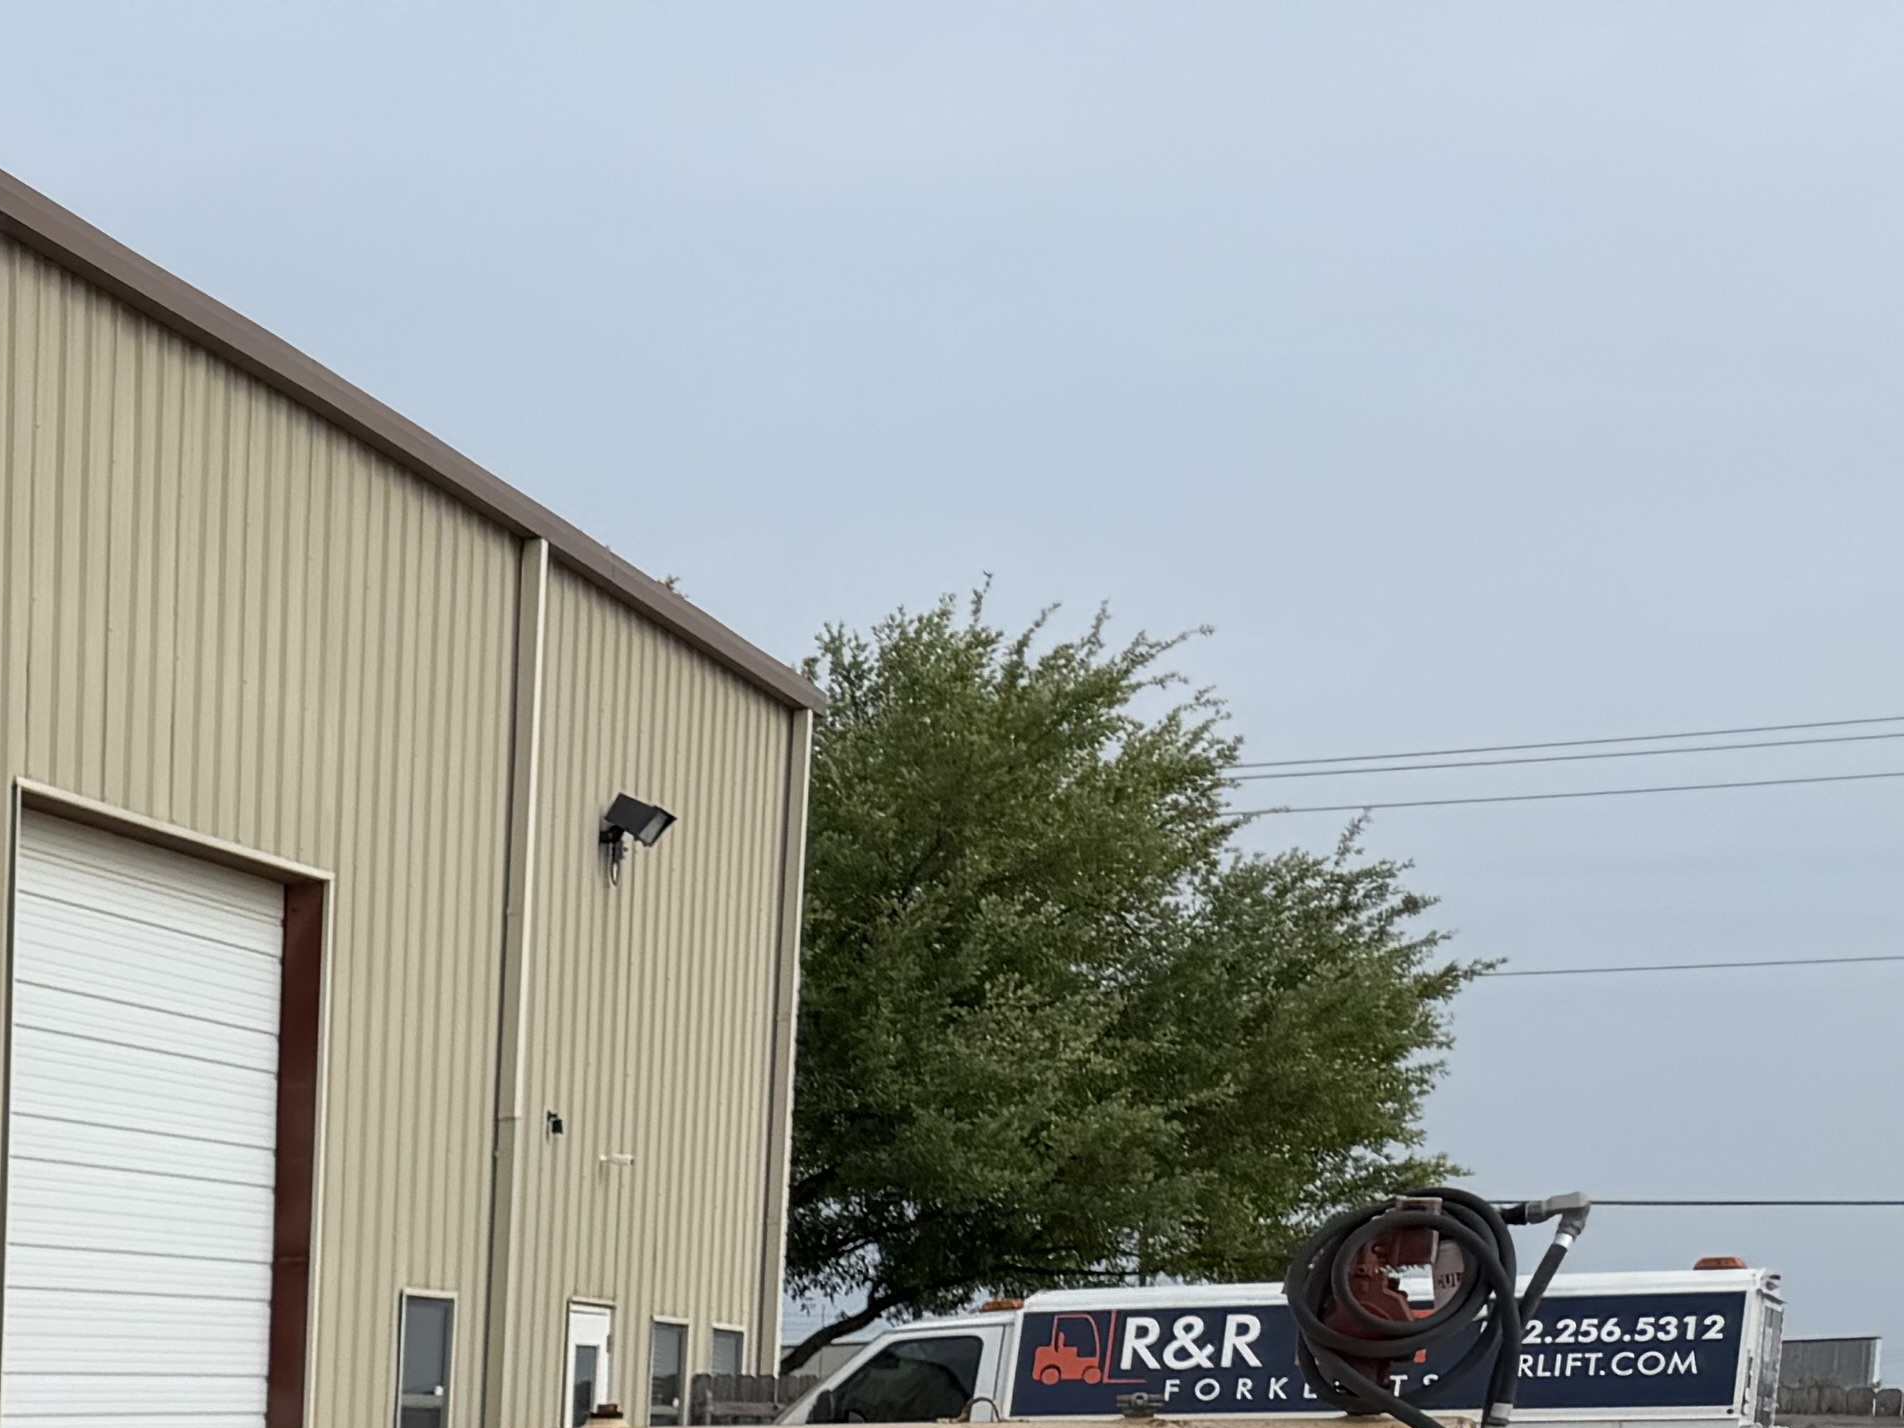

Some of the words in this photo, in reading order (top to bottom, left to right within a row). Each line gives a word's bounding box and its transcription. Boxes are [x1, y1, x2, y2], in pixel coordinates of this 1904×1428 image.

[1120, 1314, 1262, 1370] R&R
[1480, 1314, 1725, 1344] 2.256.5312
[1517, 1350, 1698, 1378] RLIFT.COM
[1163, 1374, 1439, 1402] FORKLT
